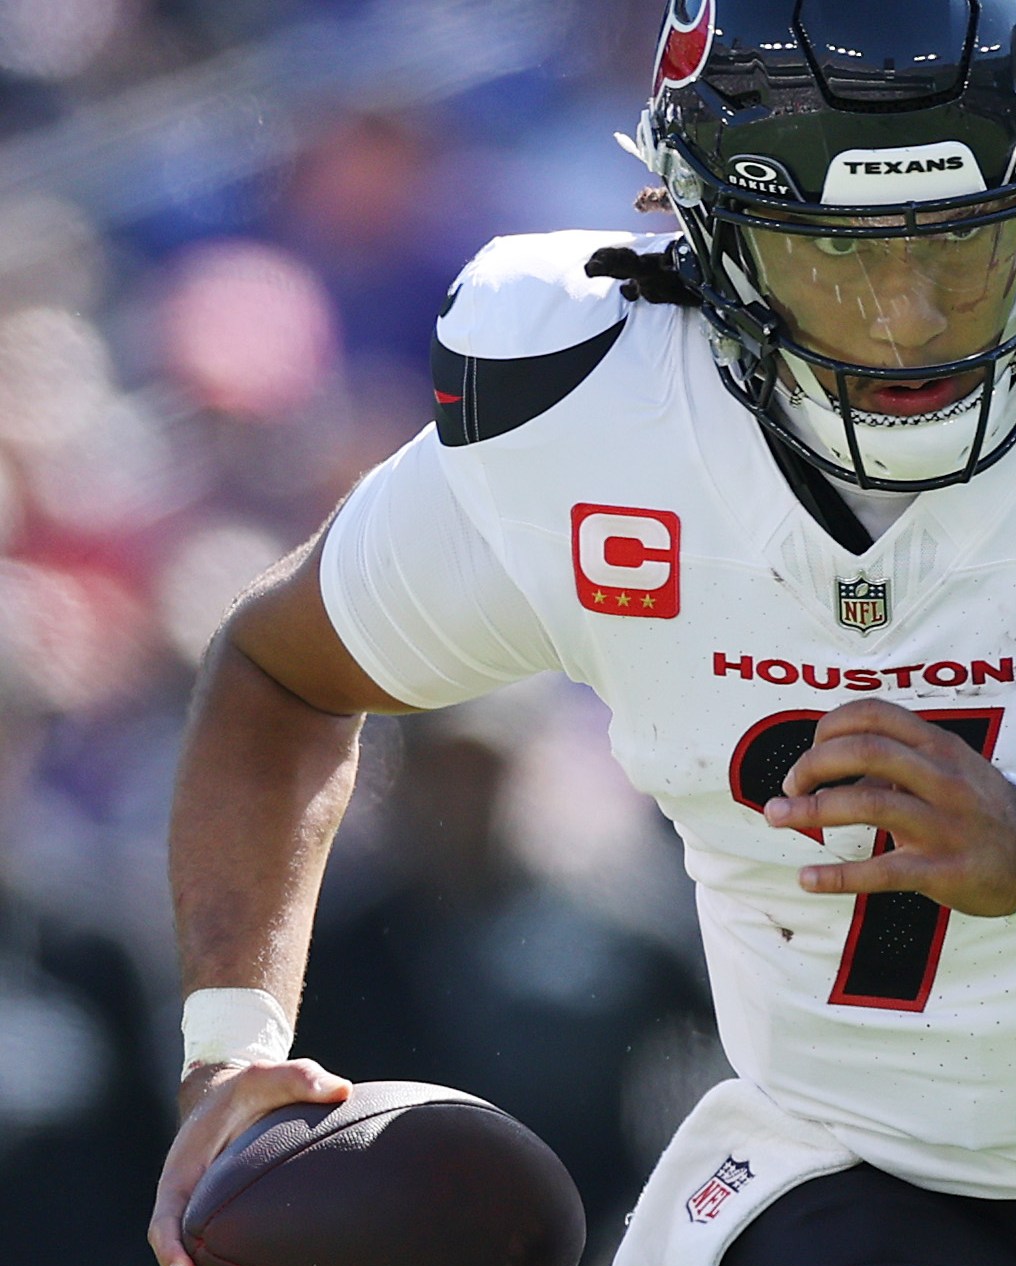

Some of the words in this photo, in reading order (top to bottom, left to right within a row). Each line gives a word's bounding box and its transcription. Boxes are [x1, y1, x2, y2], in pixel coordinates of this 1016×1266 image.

[843, 156, 964, 175] TEXANS
[728, 175, 789, 195] OAKLEY
[579, 512, 672, 591] C
[843, 601, 883, 625] NFL
[713, 652, 1015, 691] HOUSTON
[692, 1180, 731, 1219] NFL
